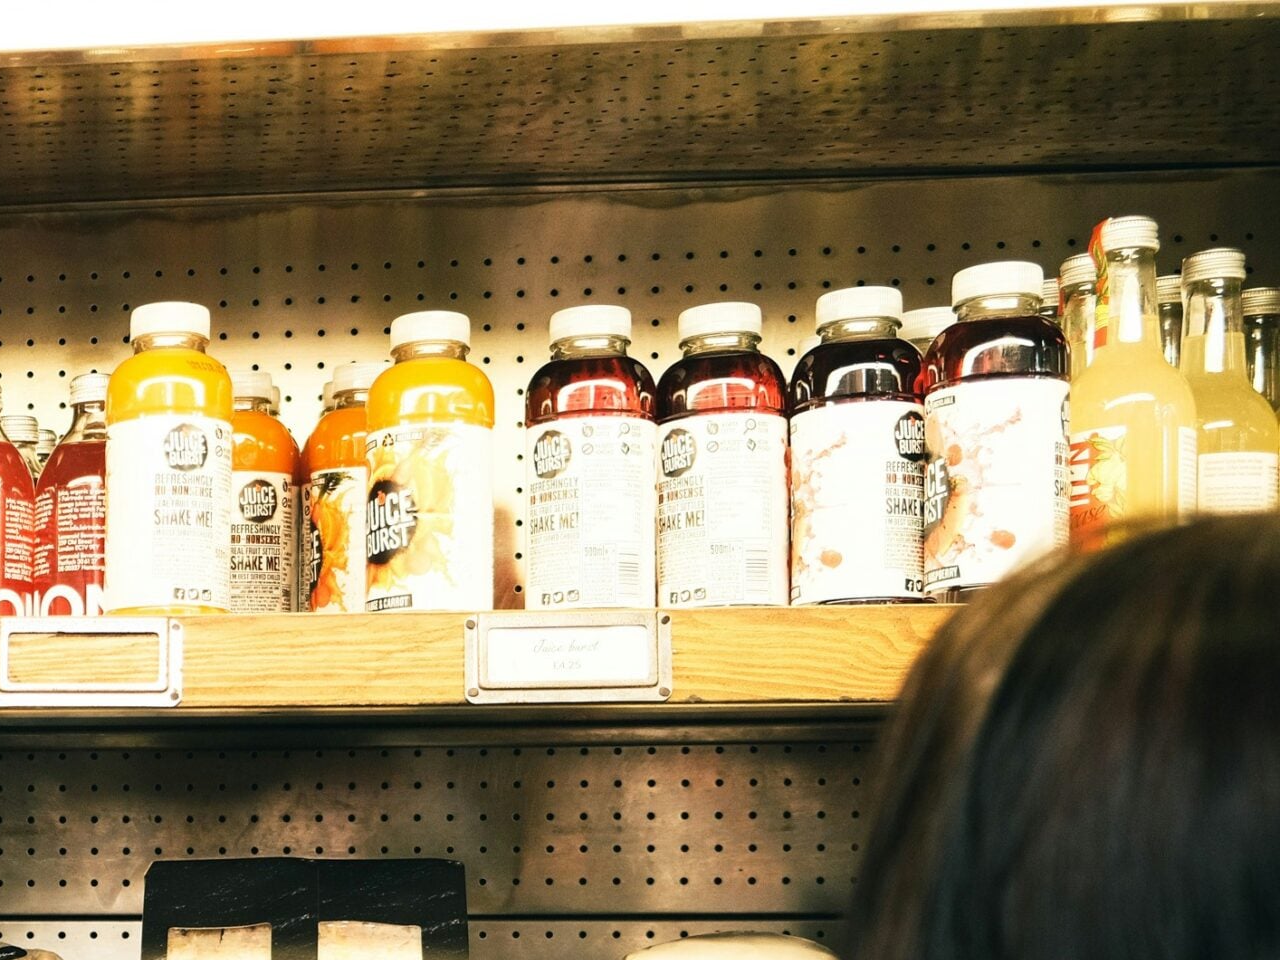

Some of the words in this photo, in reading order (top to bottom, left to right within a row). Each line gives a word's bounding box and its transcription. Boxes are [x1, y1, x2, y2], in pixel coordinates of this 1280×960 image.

[243, 502, 275, 518] BURST
[885, 497, 918, 515] SHAKE
[154, 509, 191, 526] SHAKE
[530, 513, 556, 536] SHAKE
[231, 524, 280, 535] REFRESHINGLY
[231, 555, 263, 571] SHAKE
[266, 556, 281, 572] ME!
